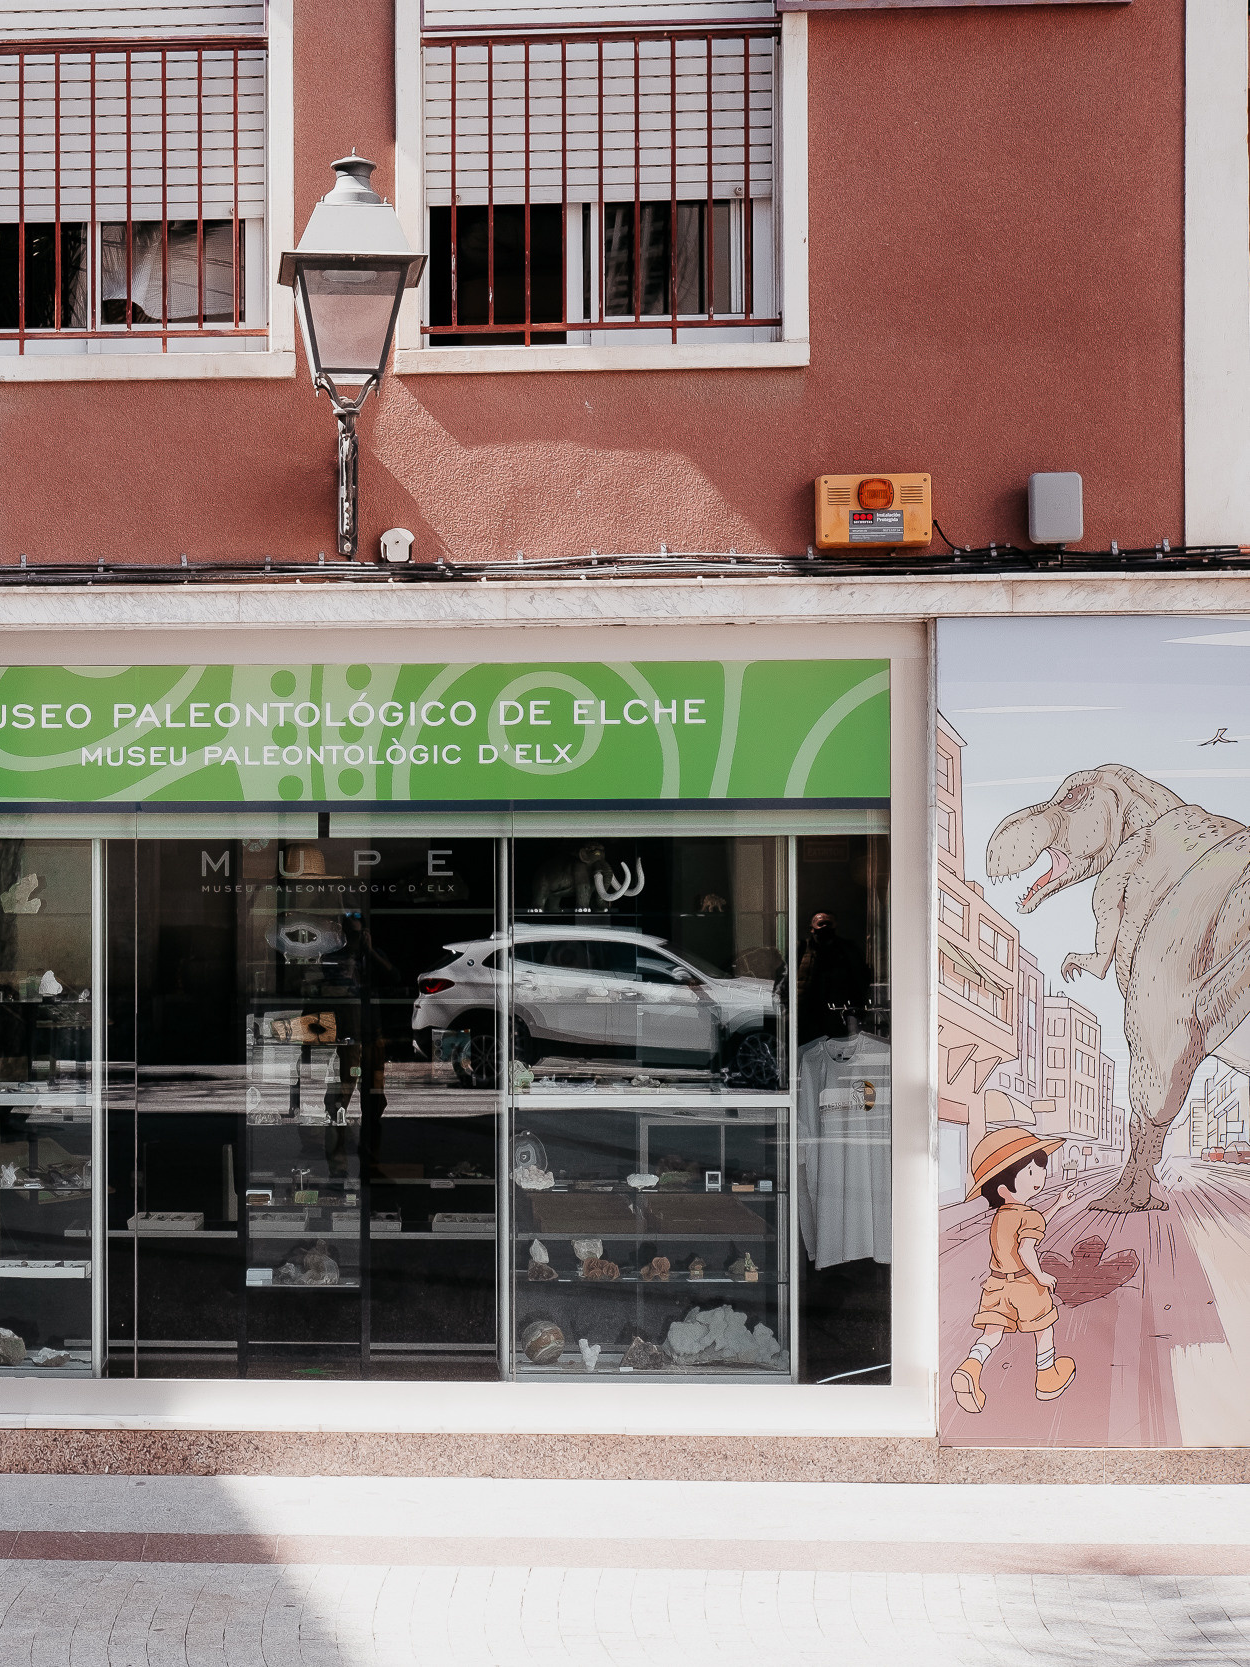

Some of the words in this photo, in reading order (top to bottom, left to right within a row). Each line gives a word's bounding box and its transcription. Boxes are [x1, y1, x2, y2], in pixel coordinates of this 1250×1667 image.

[114, 693, 476, 728] PALEONTOLÓGICO
[499, 700, 551, 725] DE
[574, 700, 706, 725] ELCHE
[81, 747, 187, 766] MUSEU
[205, 738, 461, 766] PALEONTOLÒGIC
[479, 744, 572, 764] D'ELX
[201, 851, 453, 877] MUPE
[201, 885, 253, 893] MUSEU
[266, 883, 396, 893] PALEONTOLÒGIC
